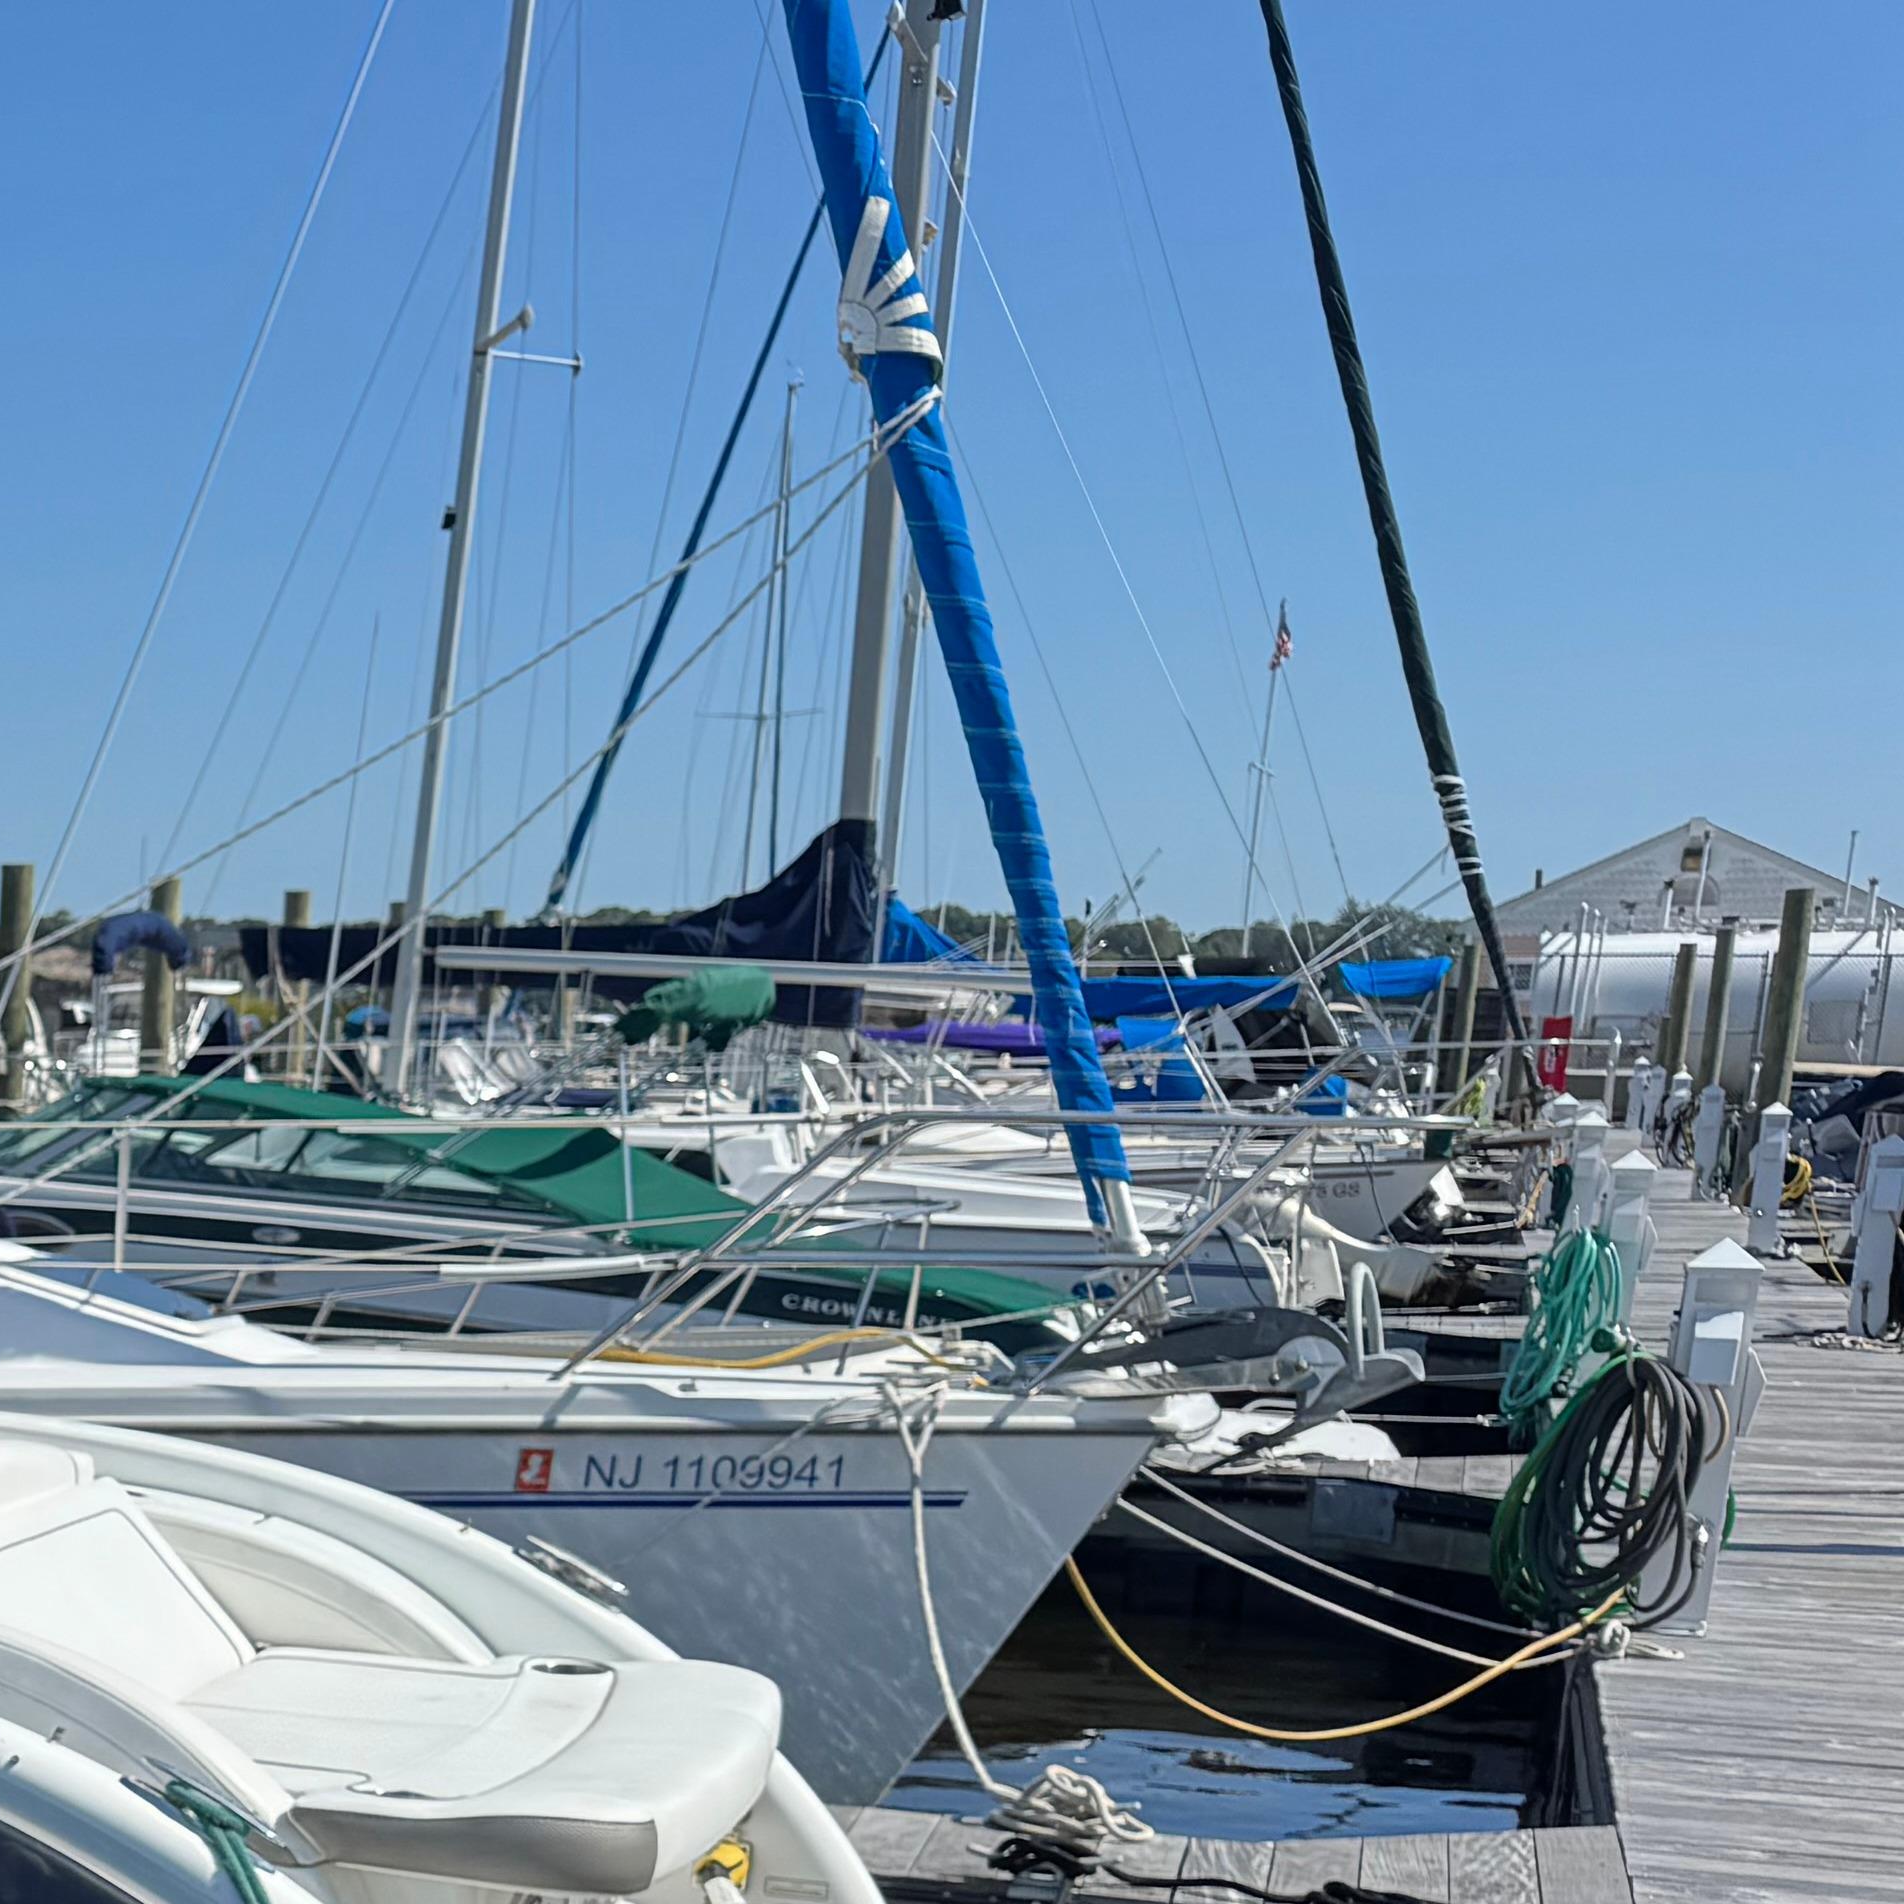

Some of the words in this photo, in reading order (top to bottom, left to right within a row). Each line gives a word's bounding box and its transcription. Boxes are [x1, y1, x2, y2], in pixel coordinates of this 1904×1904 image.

[782, 1293, 955, 1329] CROWNLN
[583, 1454, 642, 1488] NJ
[663, 1454, 845, 1490] 1109941
